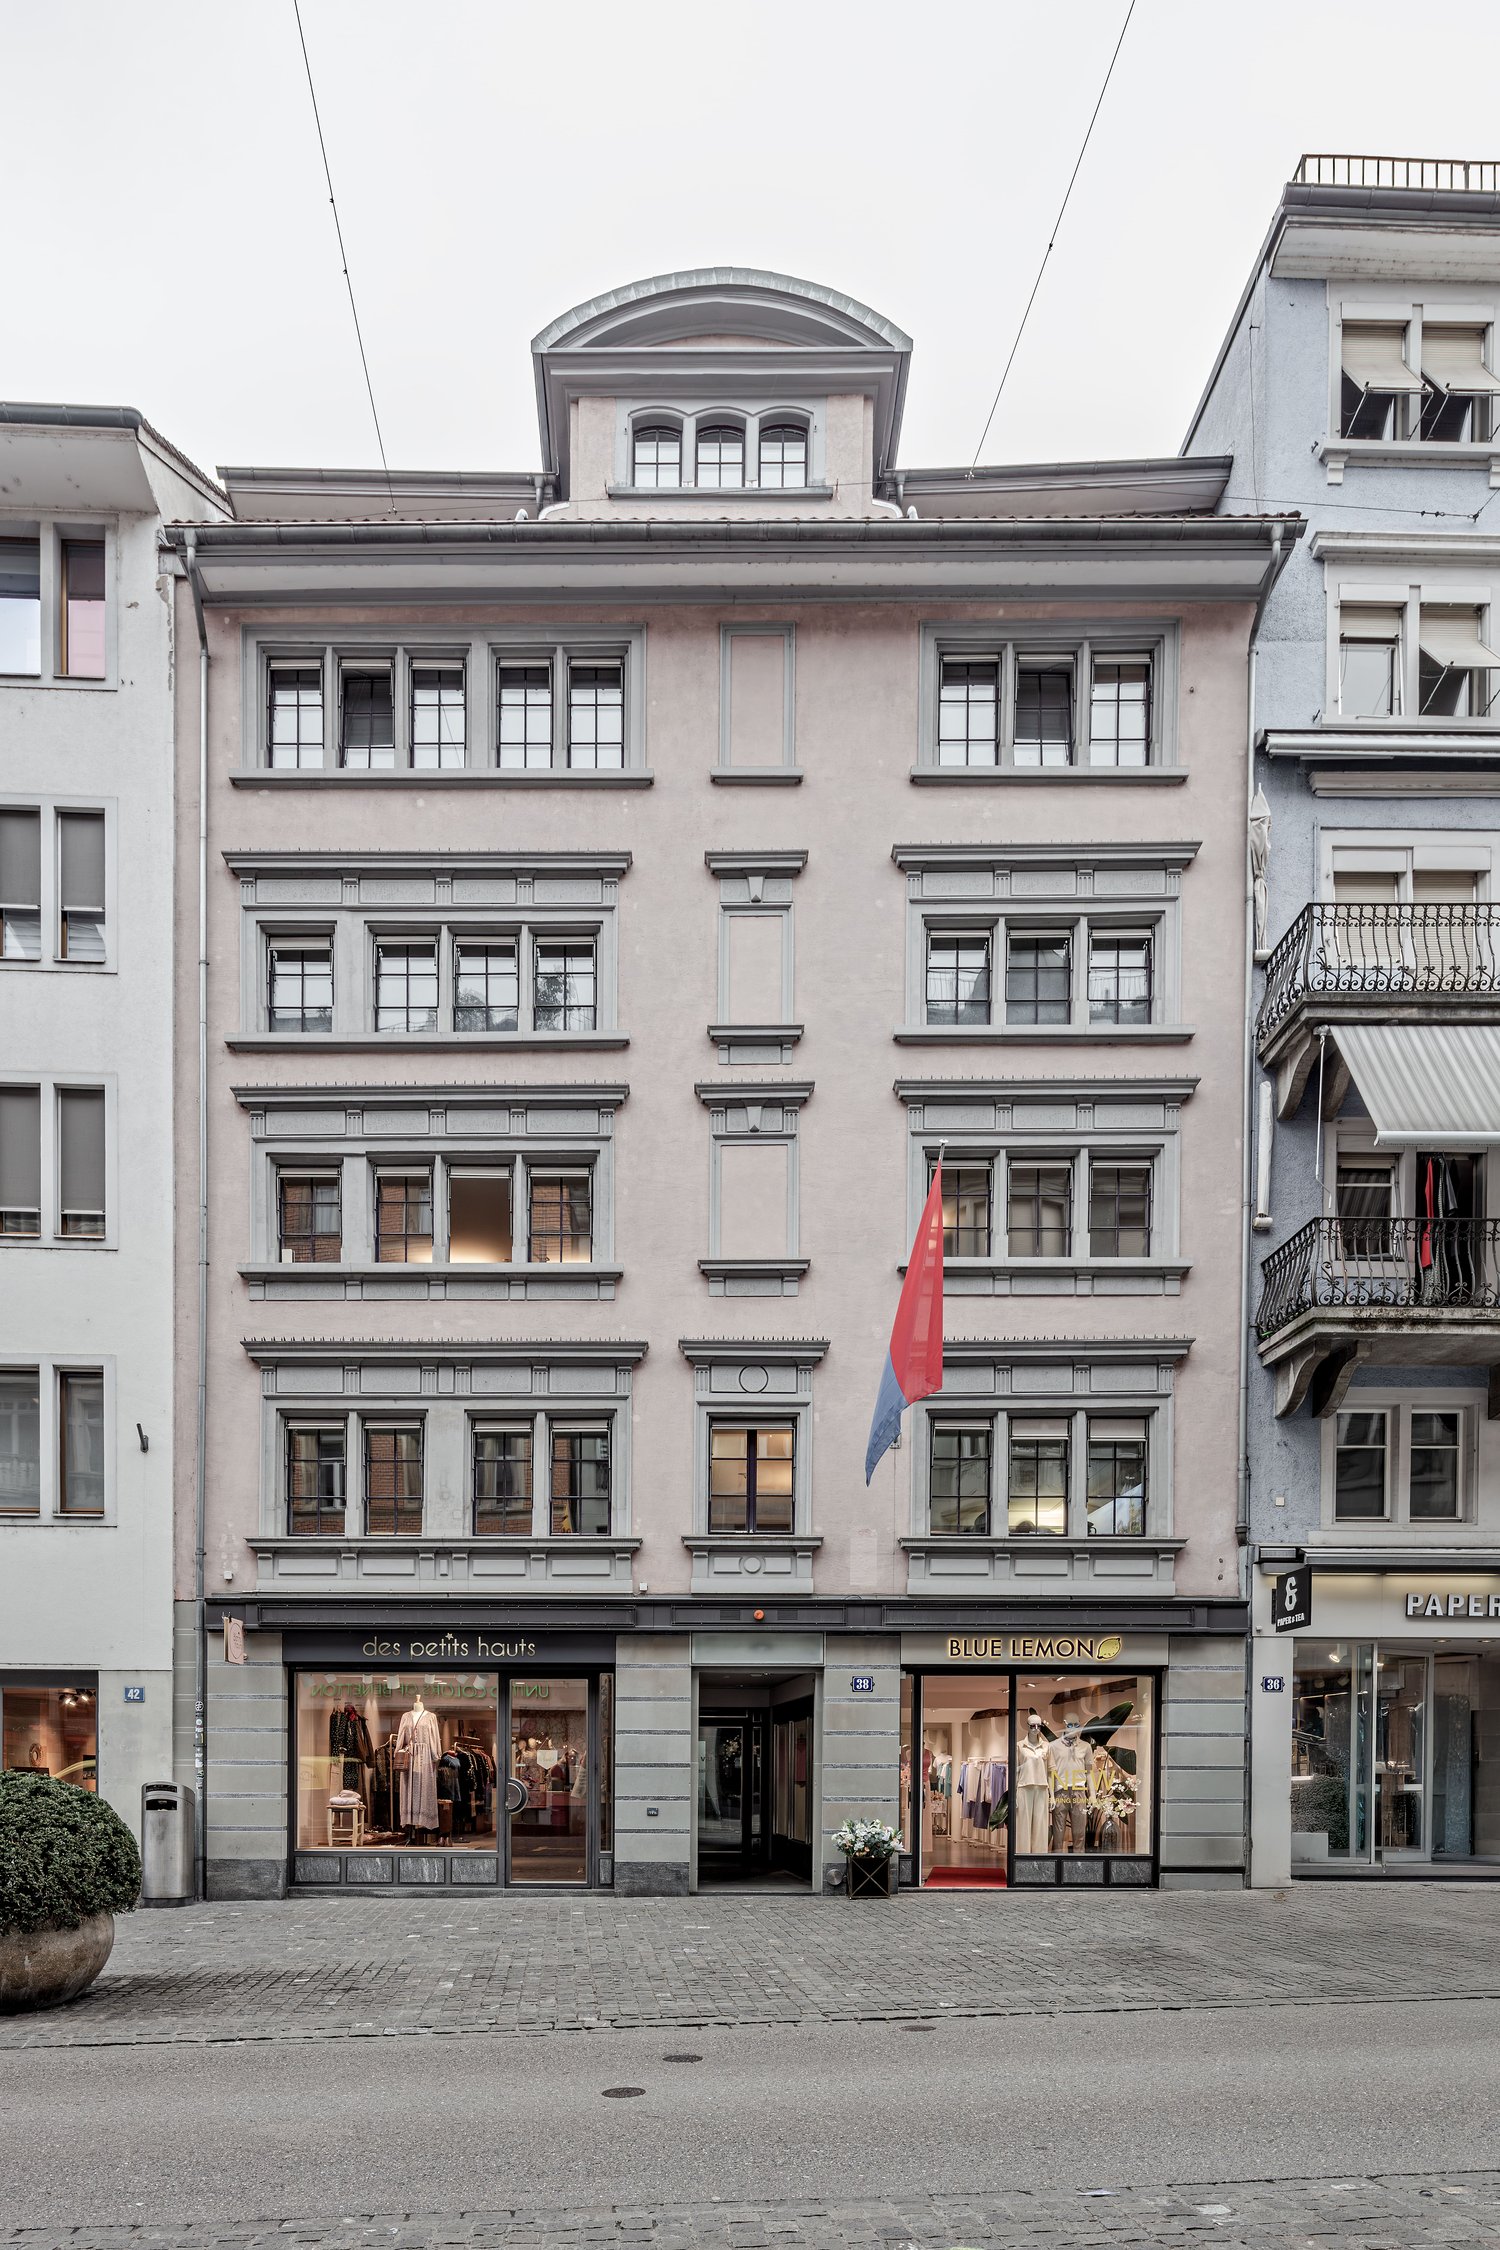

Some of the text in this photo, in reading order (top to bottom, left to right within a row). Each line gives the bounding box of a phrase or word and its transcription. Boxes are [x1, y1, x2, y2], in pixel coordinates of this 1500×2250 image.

[1406, 1593, 1500, 1617] PAPER
[1277, 1616, 1291, 1627] PAPER
[1295, 1612, 1305, 1622] TEA
[362, 1634, 536, 1660] des petits hauts
[950, 1639, 1094, 1657] BLUE LEMON
[856, 1678, 869, 1690] 38
[1267, 1678, 1280, 1690] 36
[127, 1688, 140, 1700] 42
[1051, 1770, 1116, 1791] NEW
